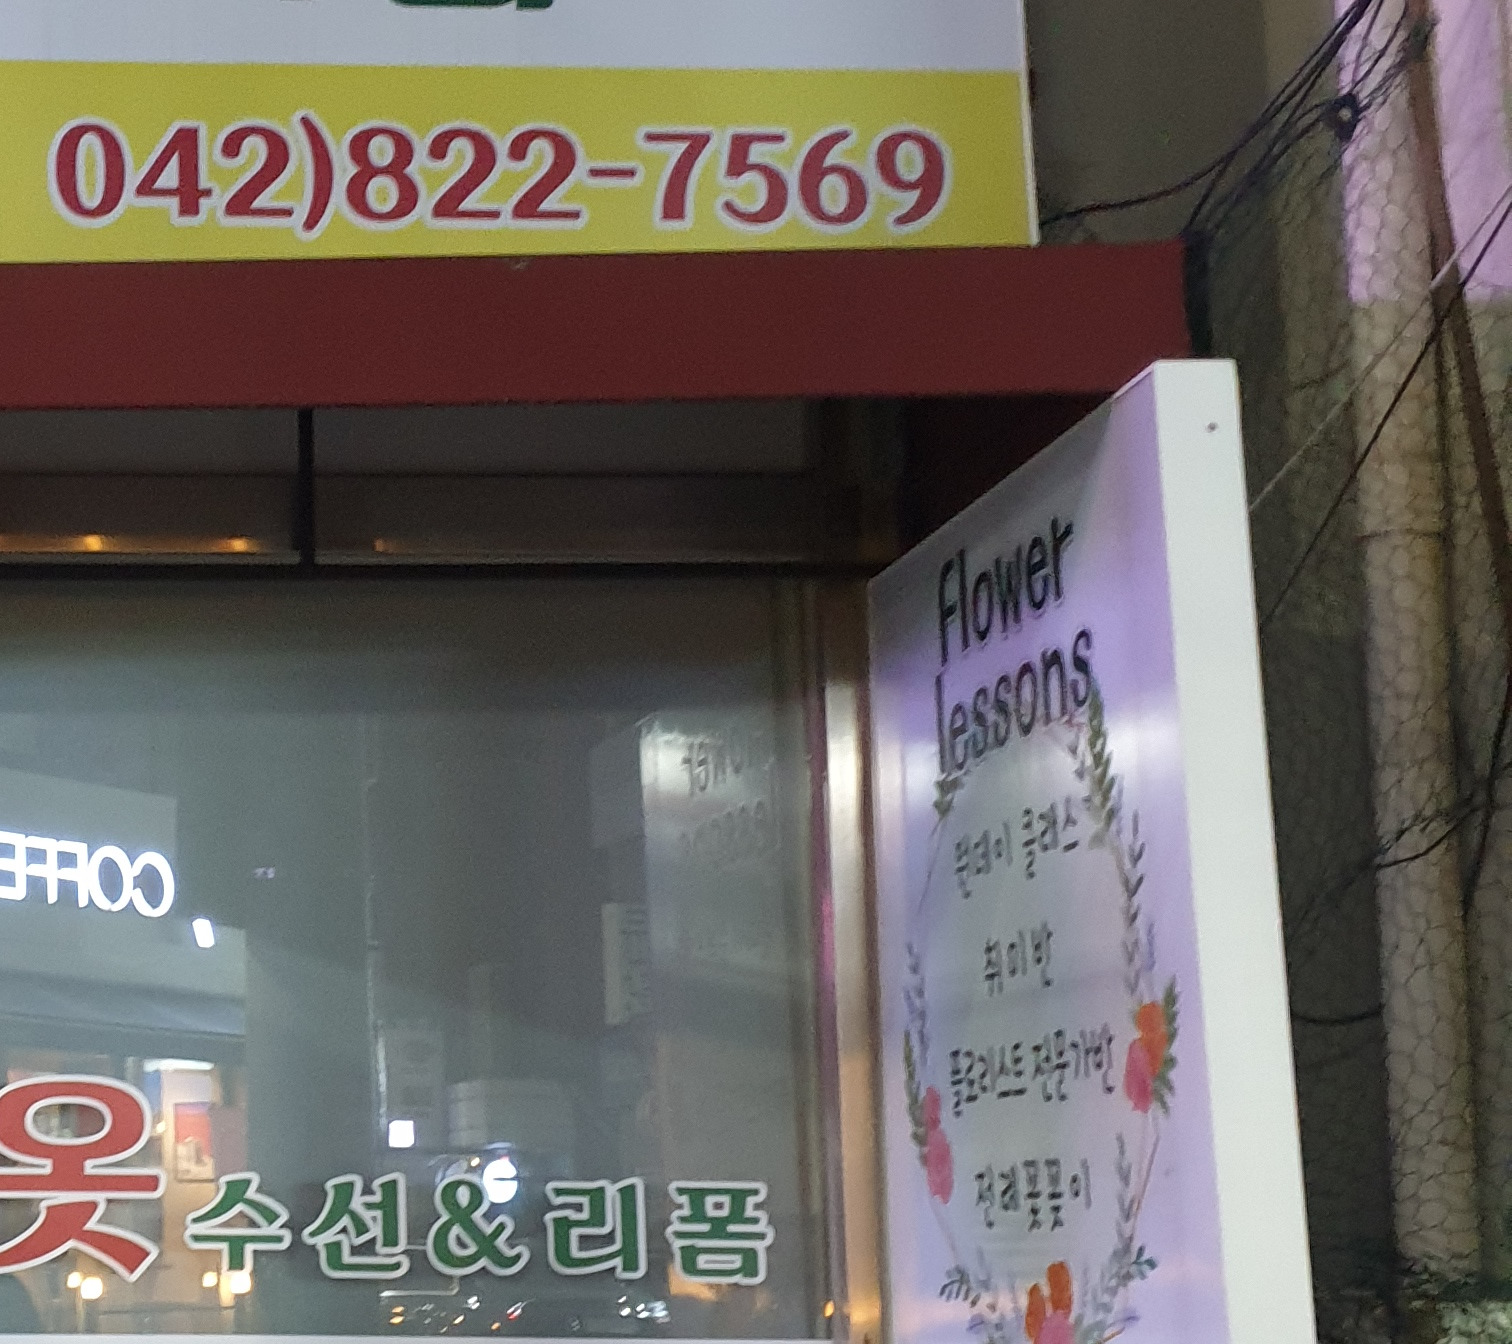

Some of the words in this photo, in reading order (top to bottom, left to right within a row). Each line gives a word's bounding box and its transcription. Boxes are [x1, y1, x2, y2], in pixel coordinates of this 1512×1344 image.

[53, 115, 946, 234] 042)822-7569
[933, 626, 1094, 773] lessons
[183, 1170, 780, 1286] 수선&리폼
